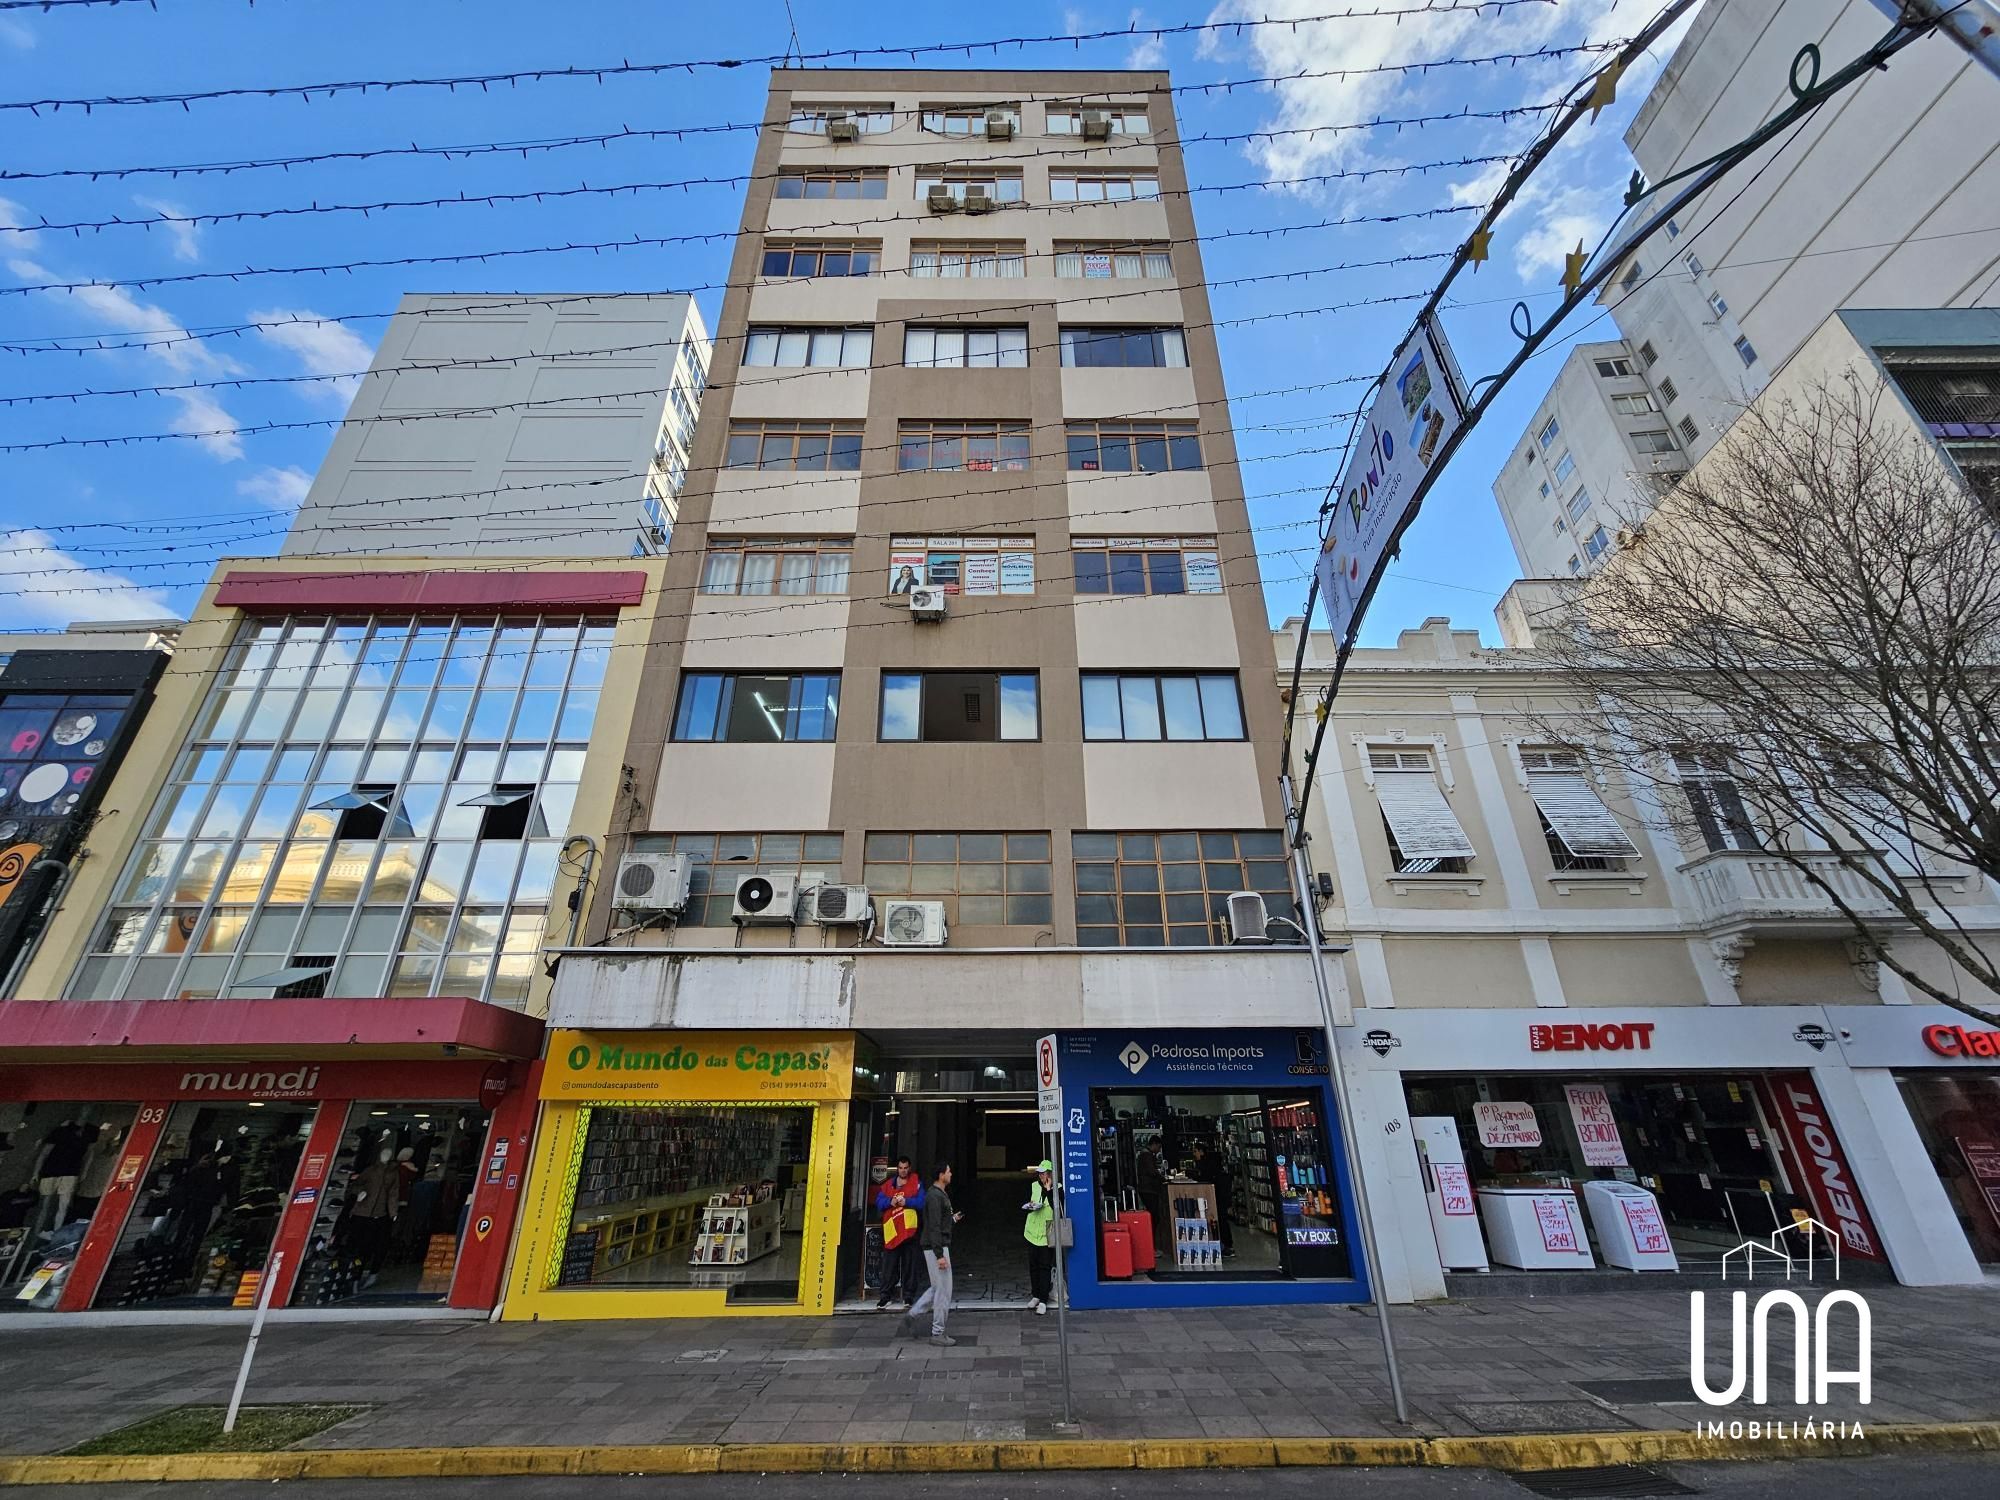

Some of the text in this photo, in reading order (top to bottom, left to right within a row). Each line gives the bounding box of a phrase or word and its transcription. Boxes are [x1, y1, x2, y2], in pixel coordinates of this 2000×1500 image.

[1362, 473, 1402, 551] Pura Inspiração
[1362, 1038, 1400, 1047] CINDAPA
[1529, 1023, 1654, 1051] BENOIT
[1531, 1026, 1540, 1049] LOJAS
[1795, 1032, 1833, 1042] CINDAPA
[568, 1045, 591, 1070] O
[596, 1045, 699, 1071] Mundo
[705, 1055, 728, 1068] das
[1151, 1044, 1264, 1063] Pedrosa Imports
[1166, 1062, 1253, 1071] Assistência Técnica
[1287, 1065, 1329, 1075] CONSERTO
[180, 1066, 320, 1091] mundi
[484, 1077, 507, 1092] mundi
[571, 1081, 659, 1091] omundodascapasbento
[253, 1090, 313, 1098] calçados
[1569, 1089, 1608, 1104] FECHA
[140, 1108, 165, 1124] 93
[1491, 1105, 1534, 1126] Pagamento
[1581, 1104, 1611, 1123] MÊS
[1384, 1118, 1401, 1135] 108
[1578, 1123, 1618, 1143] BENOIT
[1487, 1131, 1541, 1144] DEZEMBRO
[824, 1145, 834, 1208] PELÍCULAS
[1785, 1082, 1875, 1257] BENOIT
[1294, 1231, 1331, 1242] TV BOX
[1847, 1239, 1872, 1254] LOJAS
[816, 1231, 827, 1309] ACESSÓRIOS
